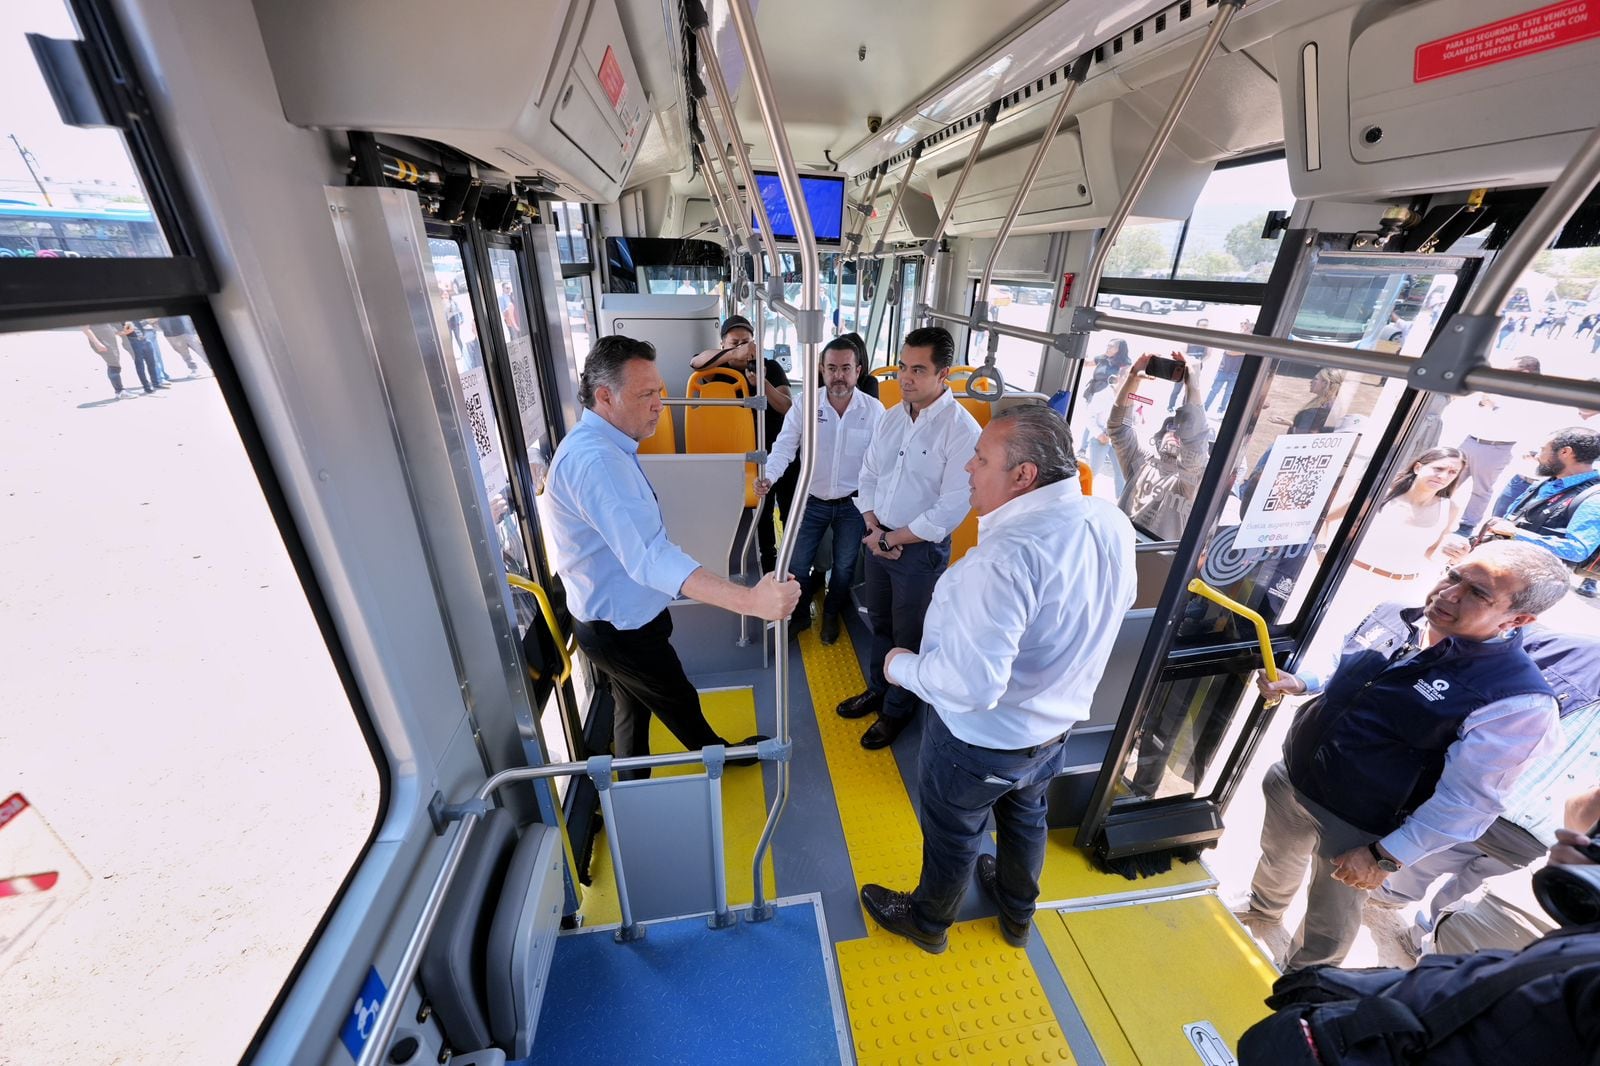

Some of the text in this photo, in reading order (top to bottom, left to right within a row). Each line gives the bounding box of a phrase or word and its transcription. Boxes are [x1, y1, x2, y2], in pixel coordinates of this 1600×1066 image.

[1442, 13, 1589, 60] SOLAMENTE SE PONE EN MARCHA CON
[1445, 40, 1464, 50] PARA
[1465, 36, 1475, 44] SU
[1523, 17, 1541, 29] ESTE
[1543, 3, 1587, 22] VEHÍCULO
[1465, 31, 1556, 63] LAS PUERTAS CERRADAS
[1311, 437, 1342, 449] 65001
